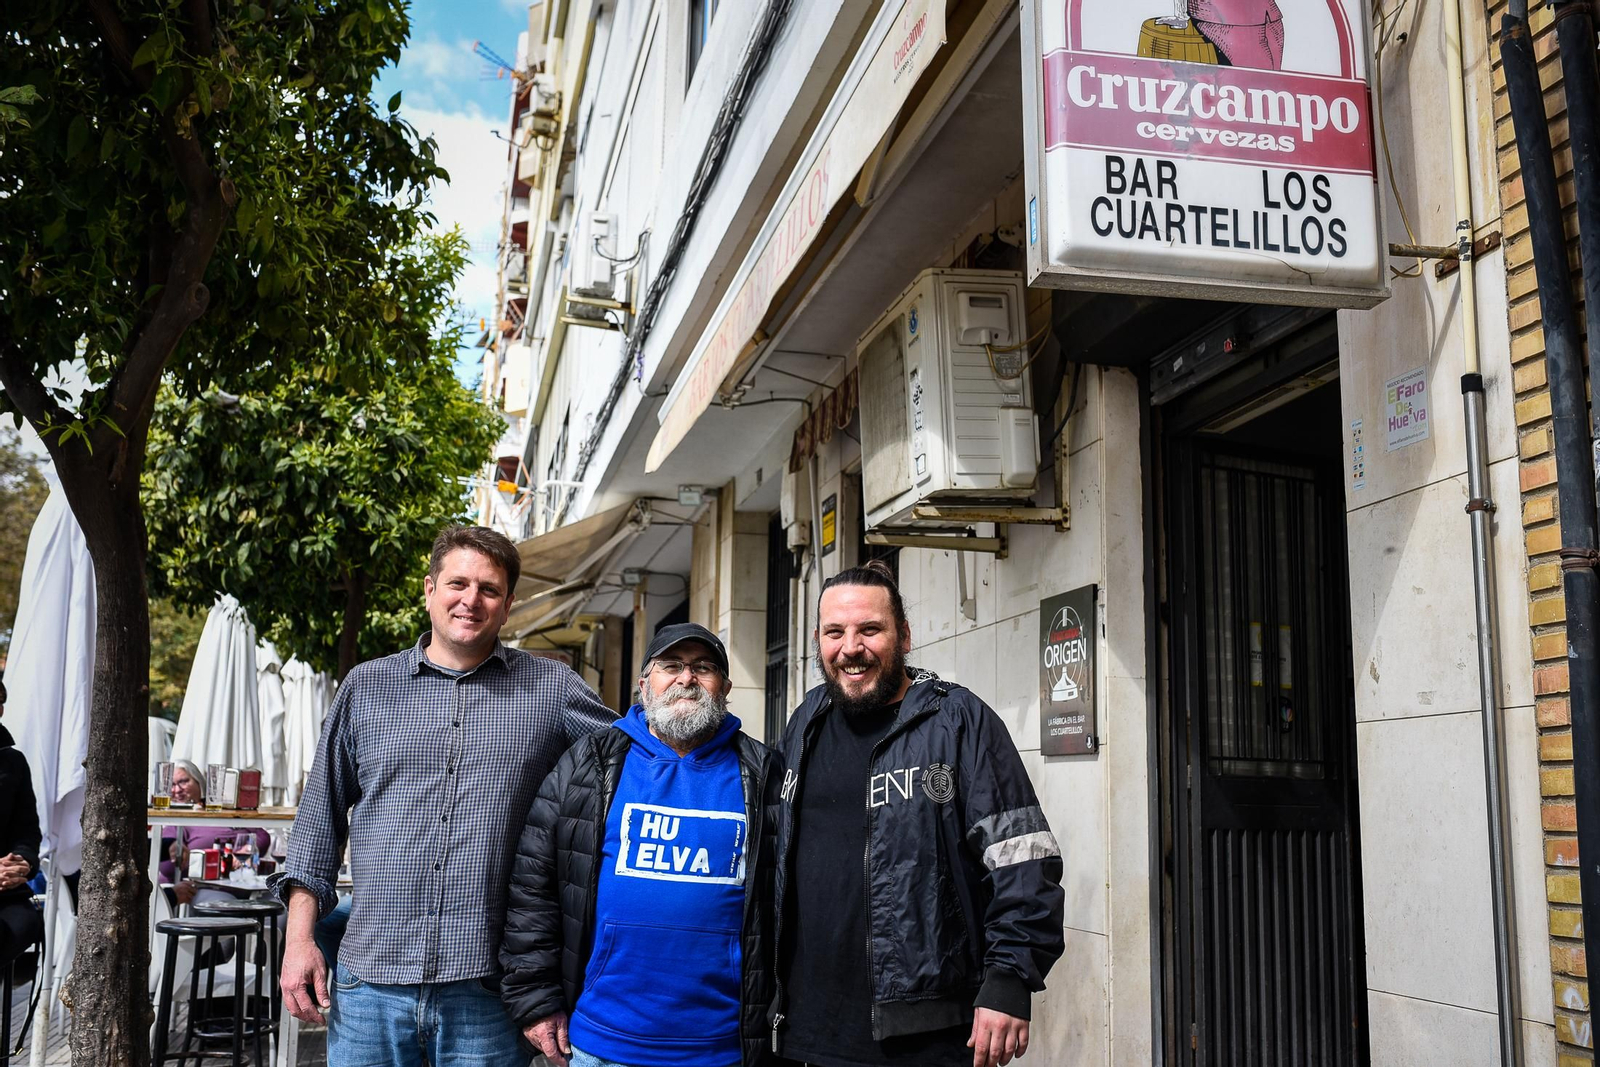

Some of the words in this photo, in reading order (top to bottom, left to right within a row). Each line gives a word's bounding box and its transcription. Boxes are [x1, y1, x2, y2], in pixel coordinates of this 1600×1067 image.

[1066, 65, 1360, 142] Cruzcampo
[1136, 121, 1296, 152] cervezas
[1105, 155, 1179, 200] BAR
[1262, 169, 1332, 214] LOS
[1090, 195, 1347, 258] CUARTELILLOS
[1044, 637, 1087, 669] ORIGEN
[640, 813, 680, 841] HU
[636, 842, 710, 874] ELVA
